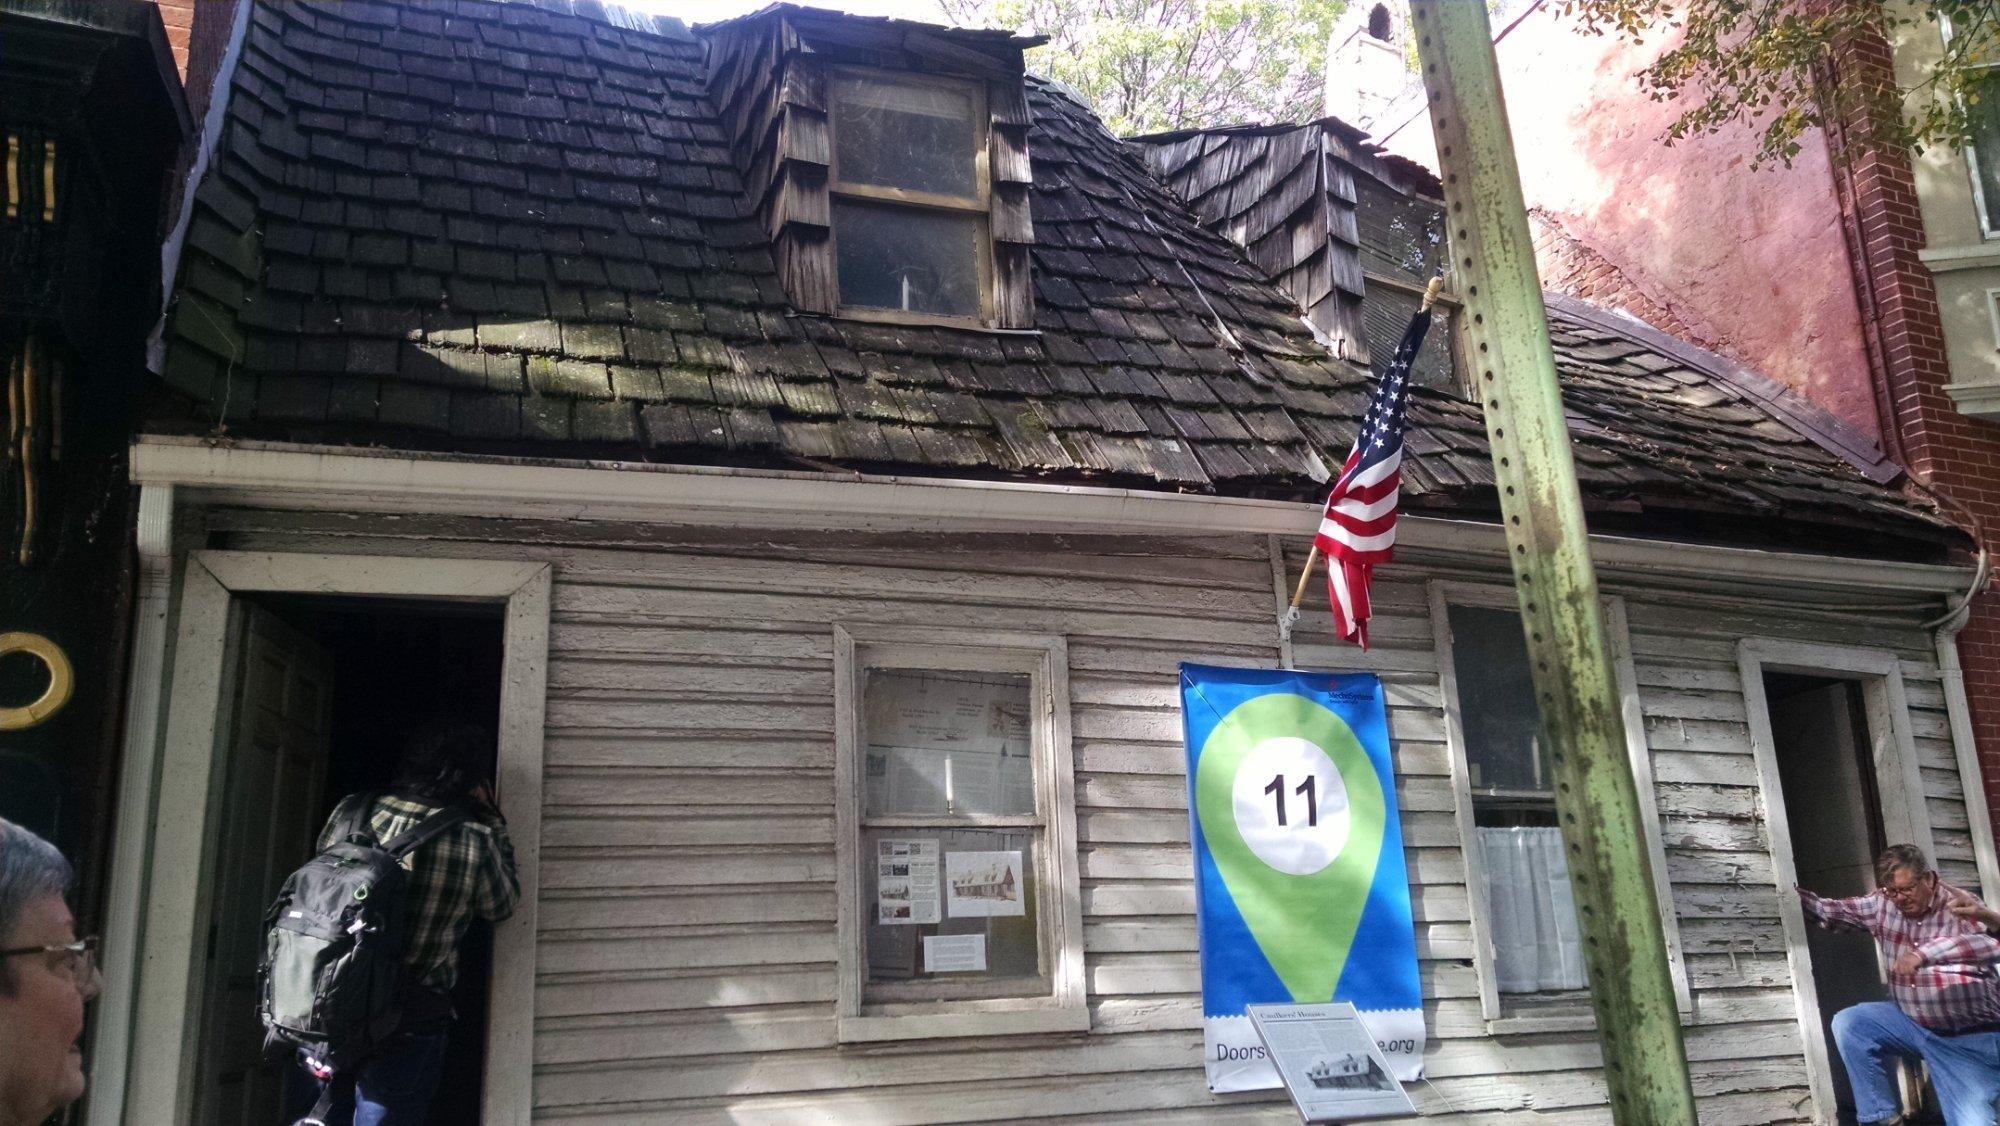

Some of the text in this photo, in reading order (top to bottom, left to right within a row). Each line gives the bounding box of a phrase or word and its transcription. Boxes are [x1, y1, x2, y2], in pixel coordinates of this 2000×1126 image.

[1265, 774, 1317, 827] 11
[1298, 1010, 1326, 1018] Houses
[1217, 1039, 1415, 1061] Doors e.org
